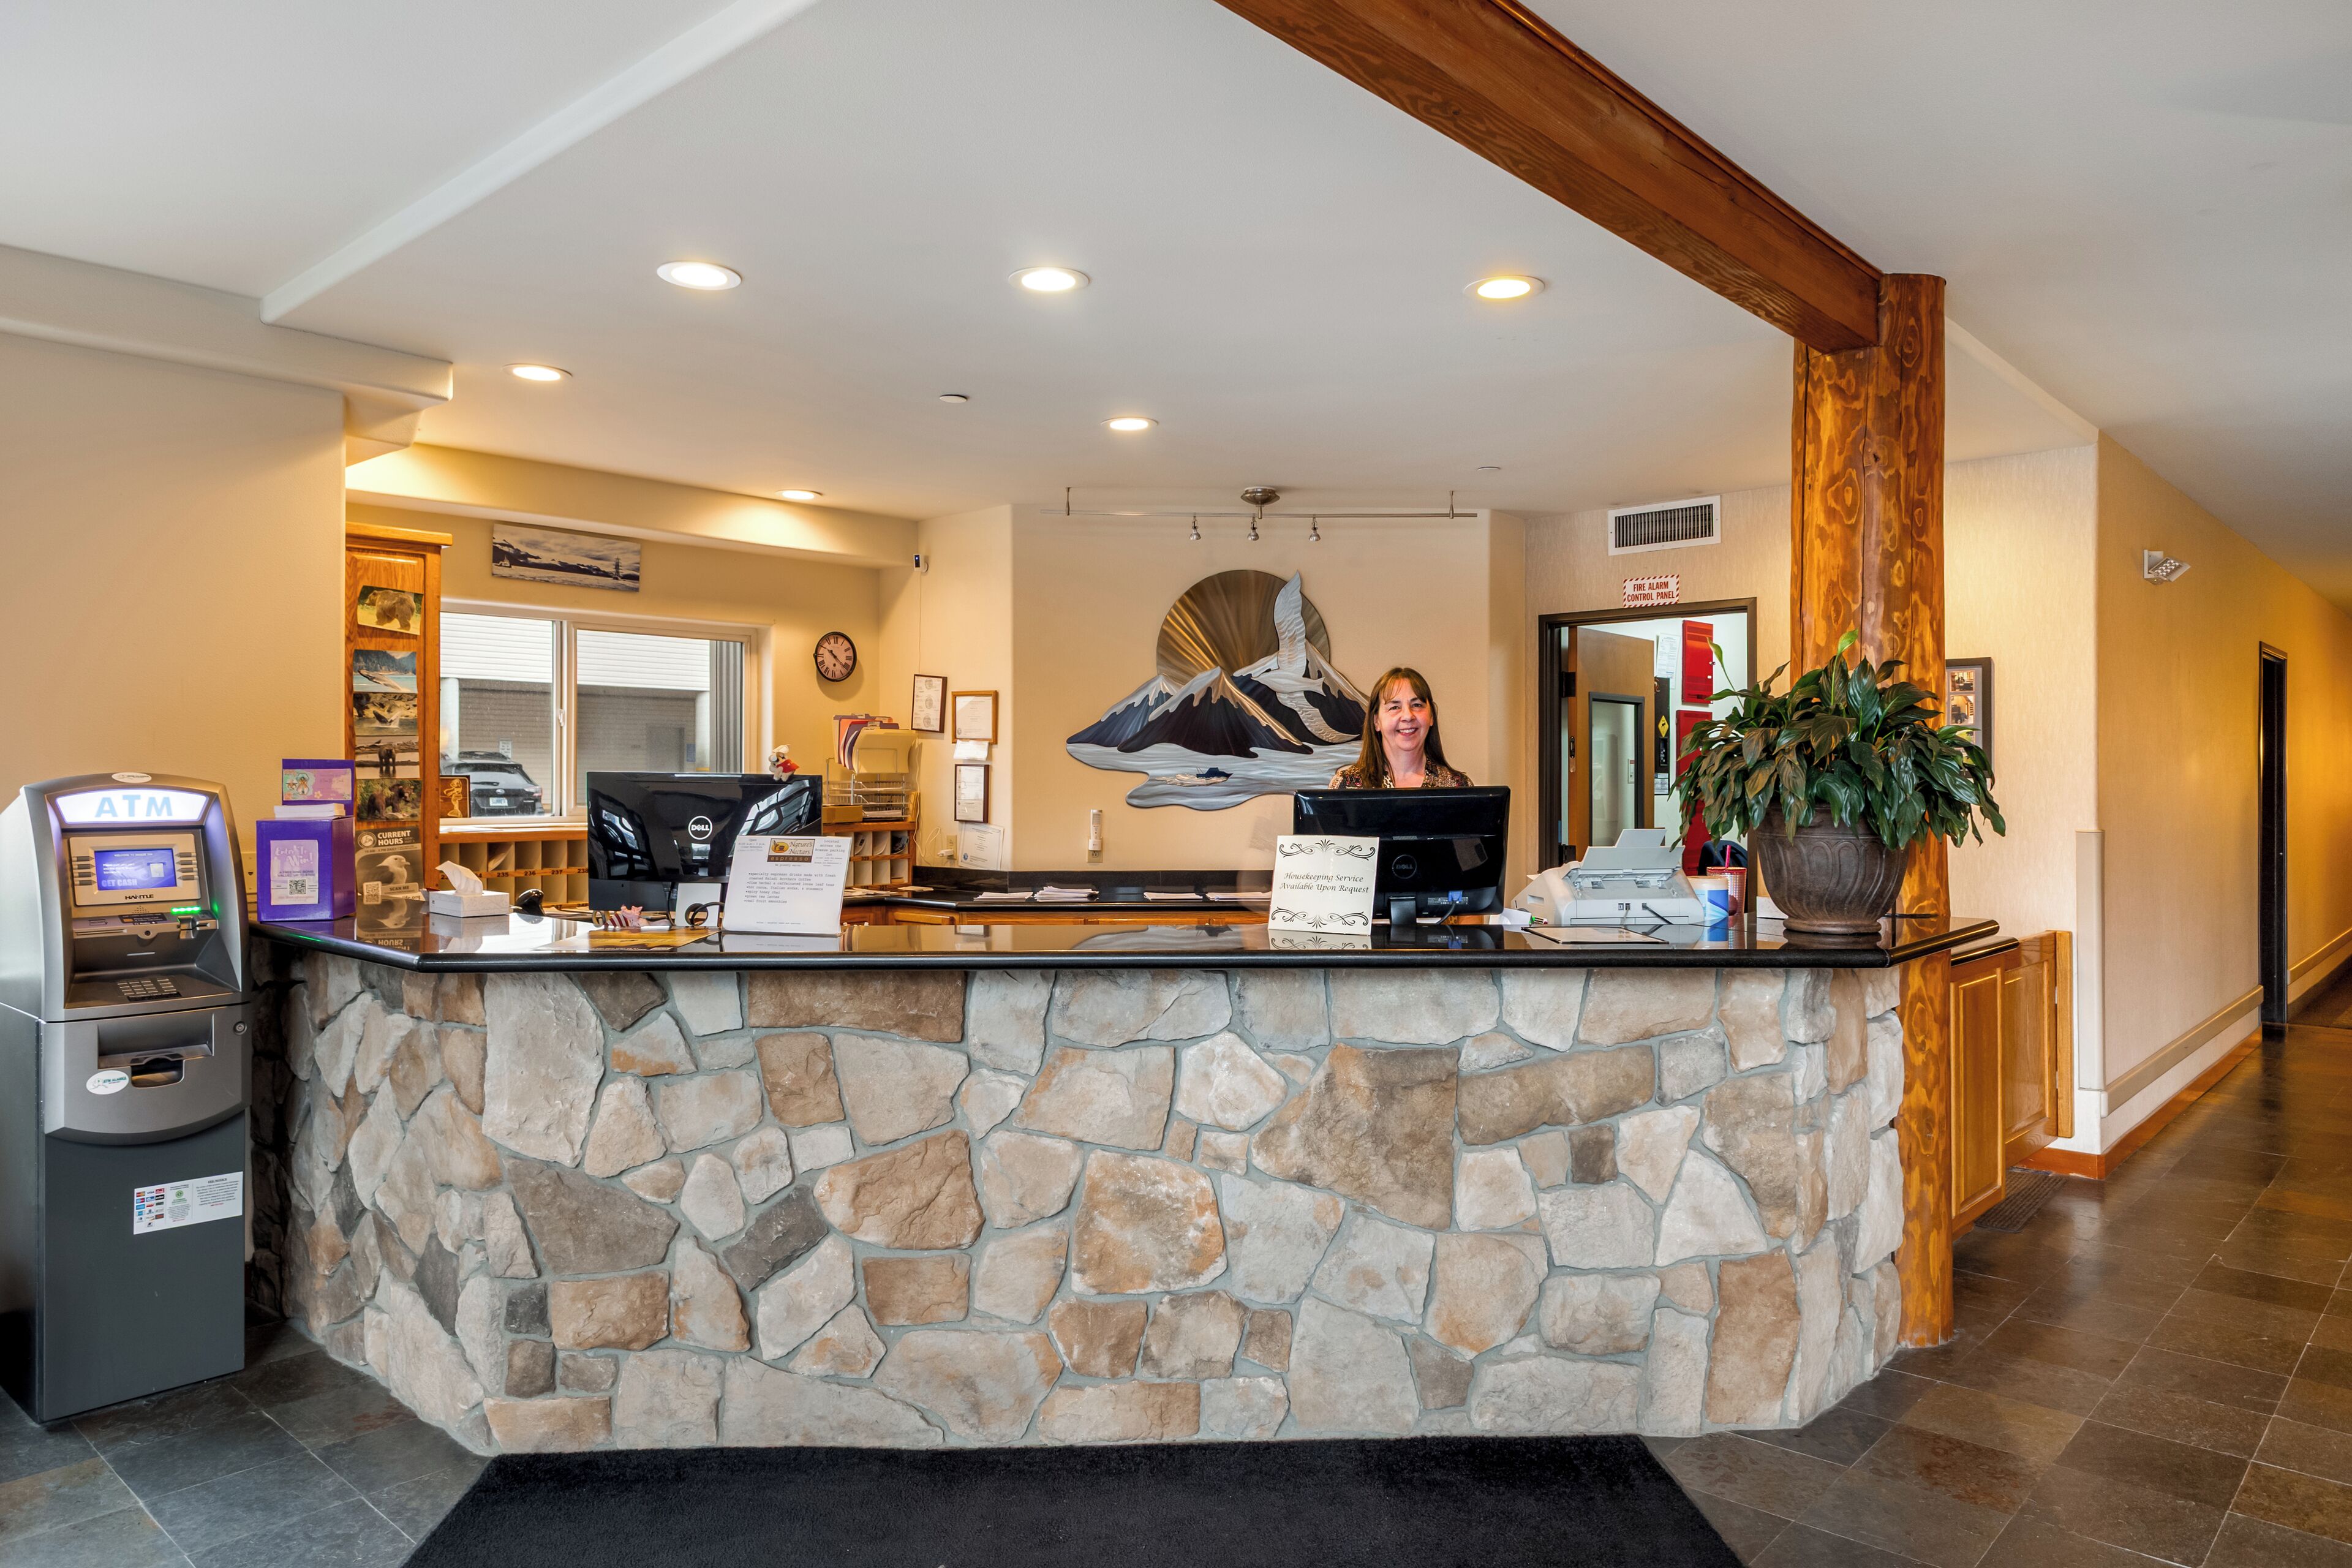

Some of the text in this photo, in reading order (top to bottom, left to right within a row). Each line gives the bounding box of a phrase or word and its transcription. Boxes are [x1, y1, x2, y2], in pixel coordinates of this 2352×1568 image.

[1633, 581, 1668, 592] FIRE ALARM
[1627, 591, 1675, 602] CONTROL PANEL
[94, 794, 173, 818] ATM
[377, 830, 411, 839] CURRENT
[378, 837, 404, 846] HOURS
[275, 846, 293, 856] Enter
[1283, 872, 1363, 883] Housekeeping Service
[1316, 884, 1336, 892] Upon
[1338, 885, 1369, 894] Request
